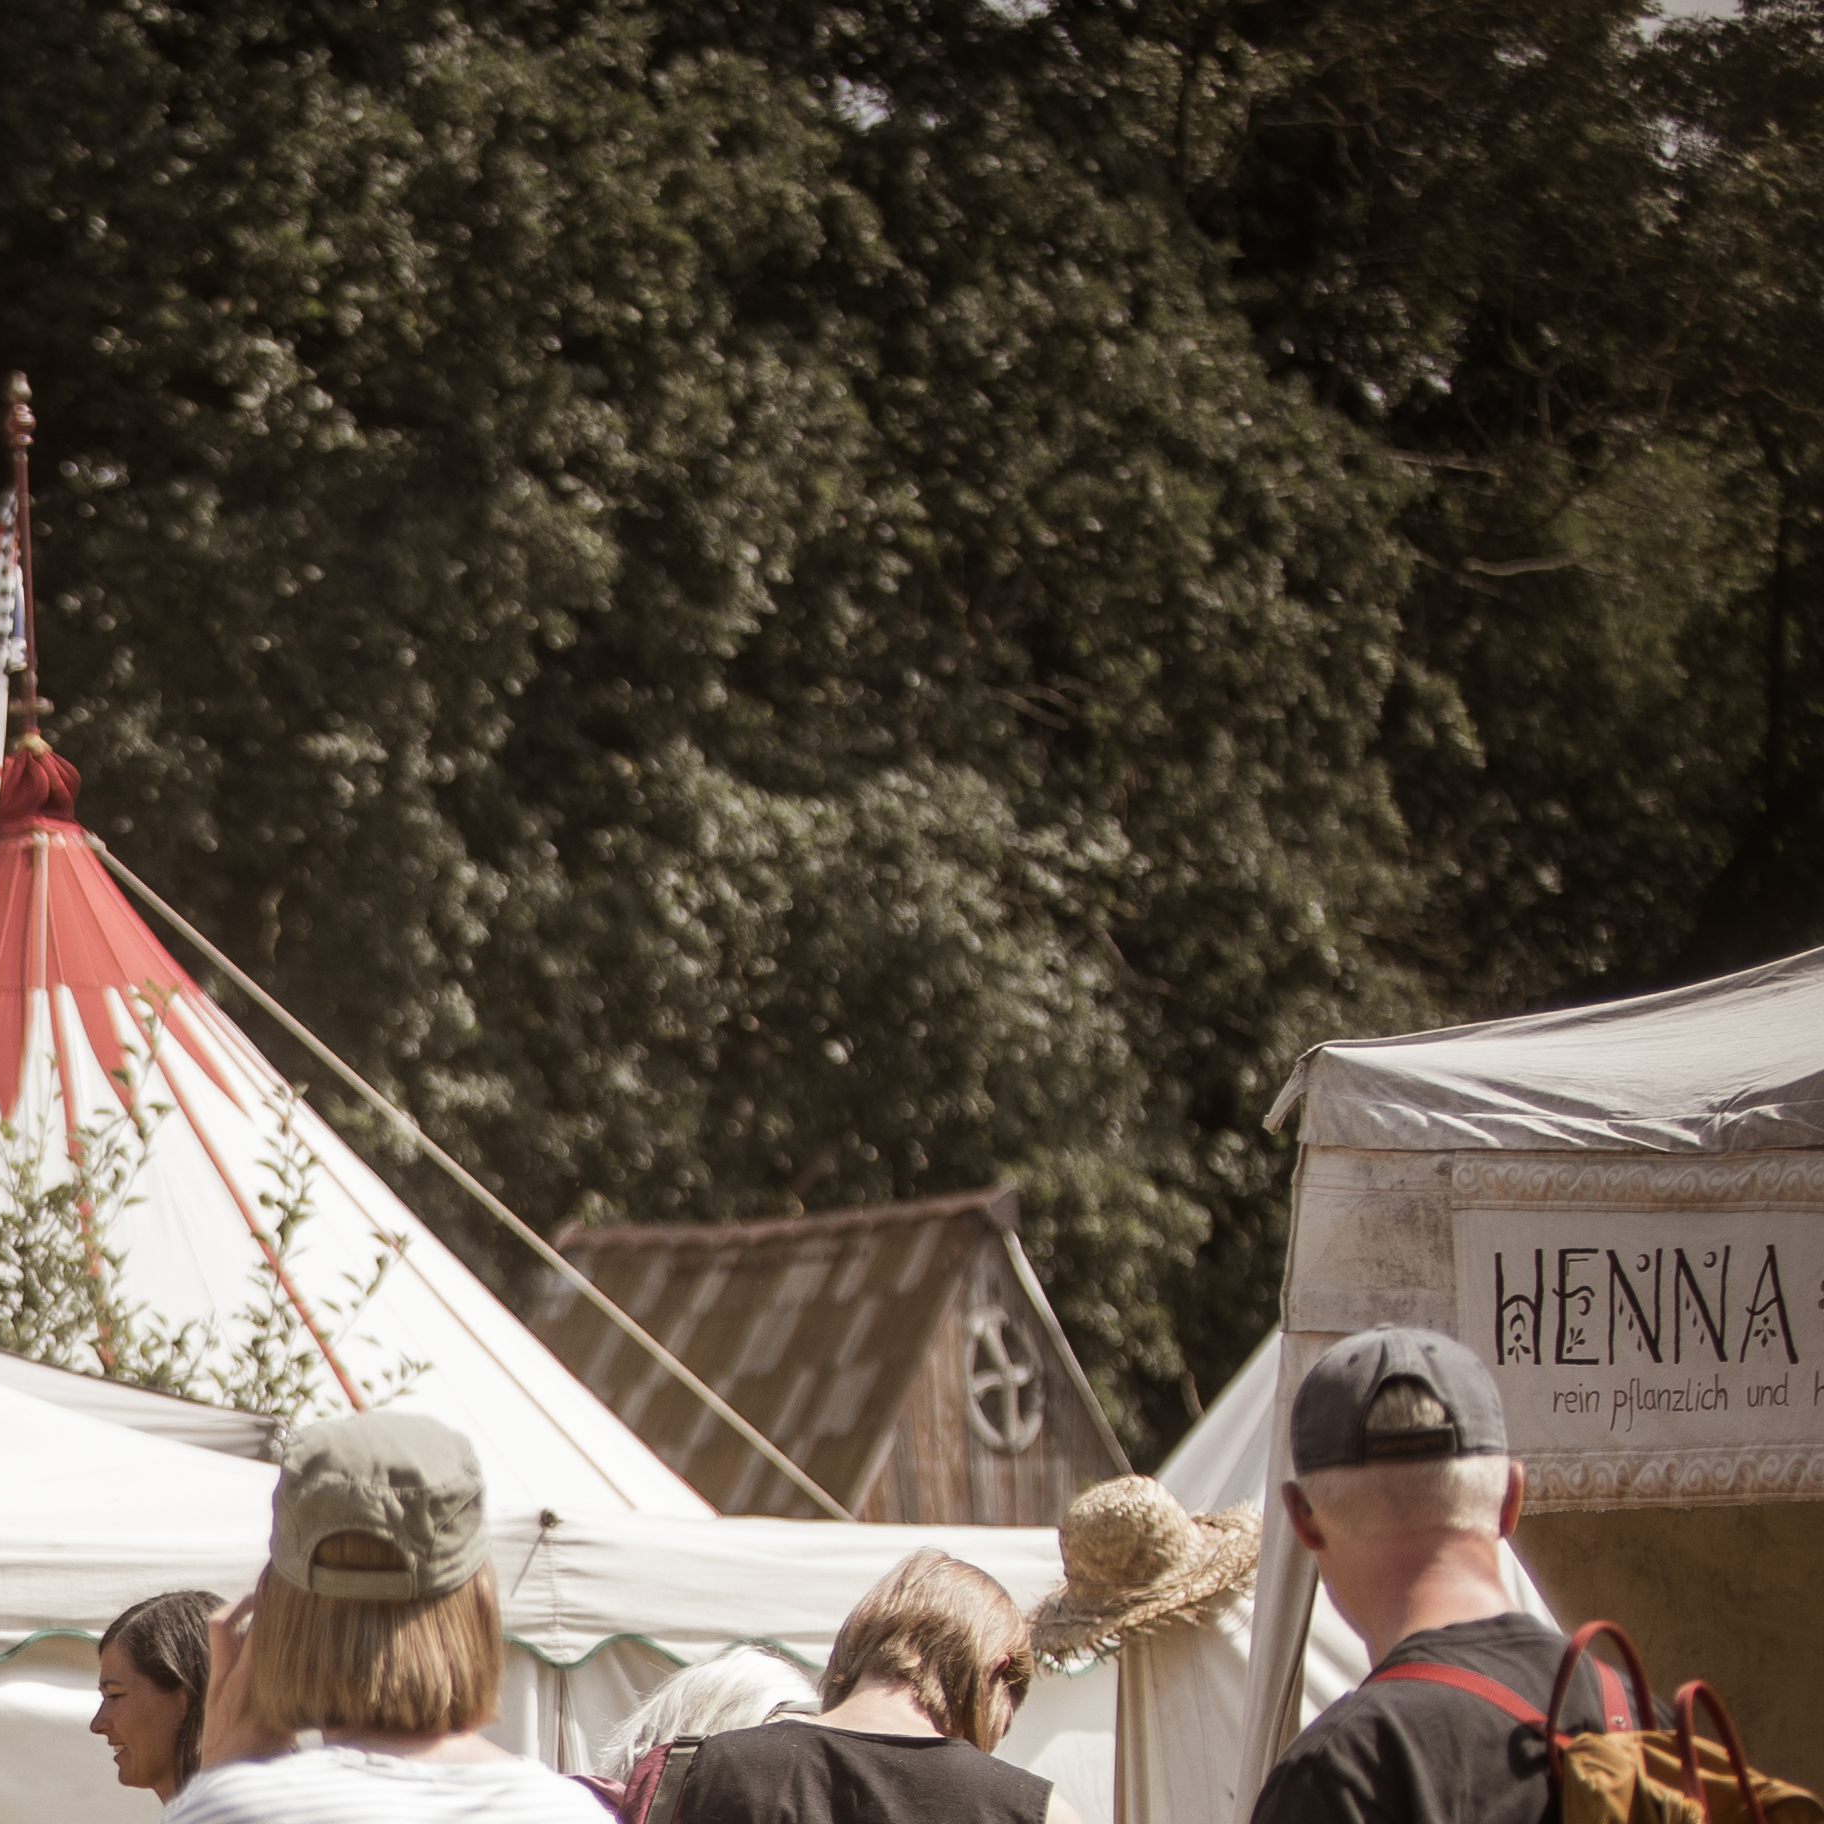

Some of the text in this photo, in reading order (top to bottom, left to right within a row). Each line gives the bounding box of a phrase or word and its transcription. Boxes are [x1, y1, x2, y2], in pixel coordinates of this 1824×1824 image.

[1494, 1244, 1799, 1366] HENNA
[1553, 1382, 1600, 1413] rein
[1609, 1373, 1728, 1432] pflanzlich
[1747, 1371, 1790, 1408] und
